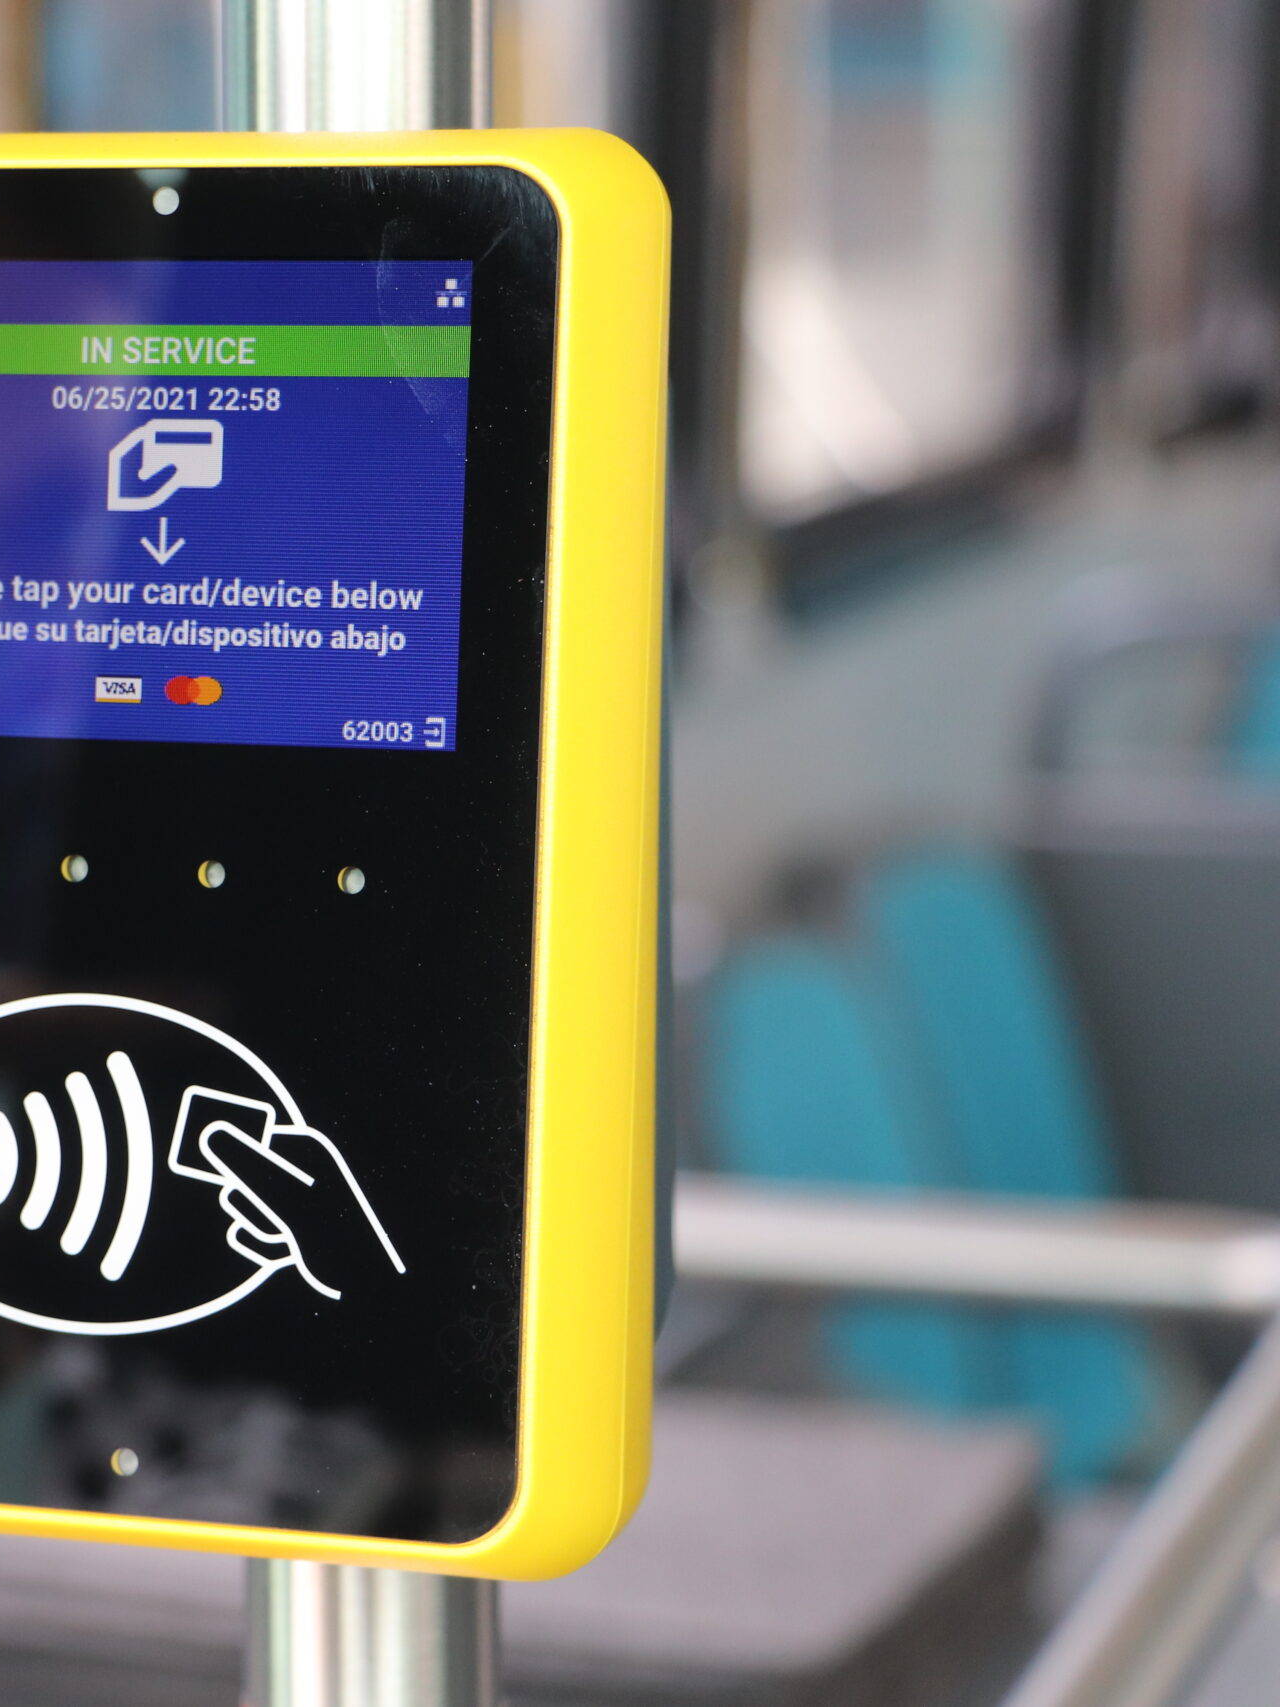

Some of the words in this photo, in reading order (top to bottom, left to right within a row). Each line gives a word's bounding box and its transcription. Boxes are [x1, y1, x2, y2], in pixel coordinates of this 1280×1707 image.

[81, 337, 112, 363] IN
[123, 338, 256, 364] SERVICE
[52, 386, 198, 412] 06/25/2021
[208, 388, 281, 412] 22:58
[12, 576, 59, 608] tap
[67, 581, 134, 609] your
[142, 577, 321, 608] card/device
[331, 581, 423, 610] below
[35, 623, 66, 642] su
[74, 618, 322, 652] tarjeta/dispositivo
[330, 625, 407, 657] abajo
[102, 681, 136, 695] VISA
[342, 720, 414, 742] 62003
